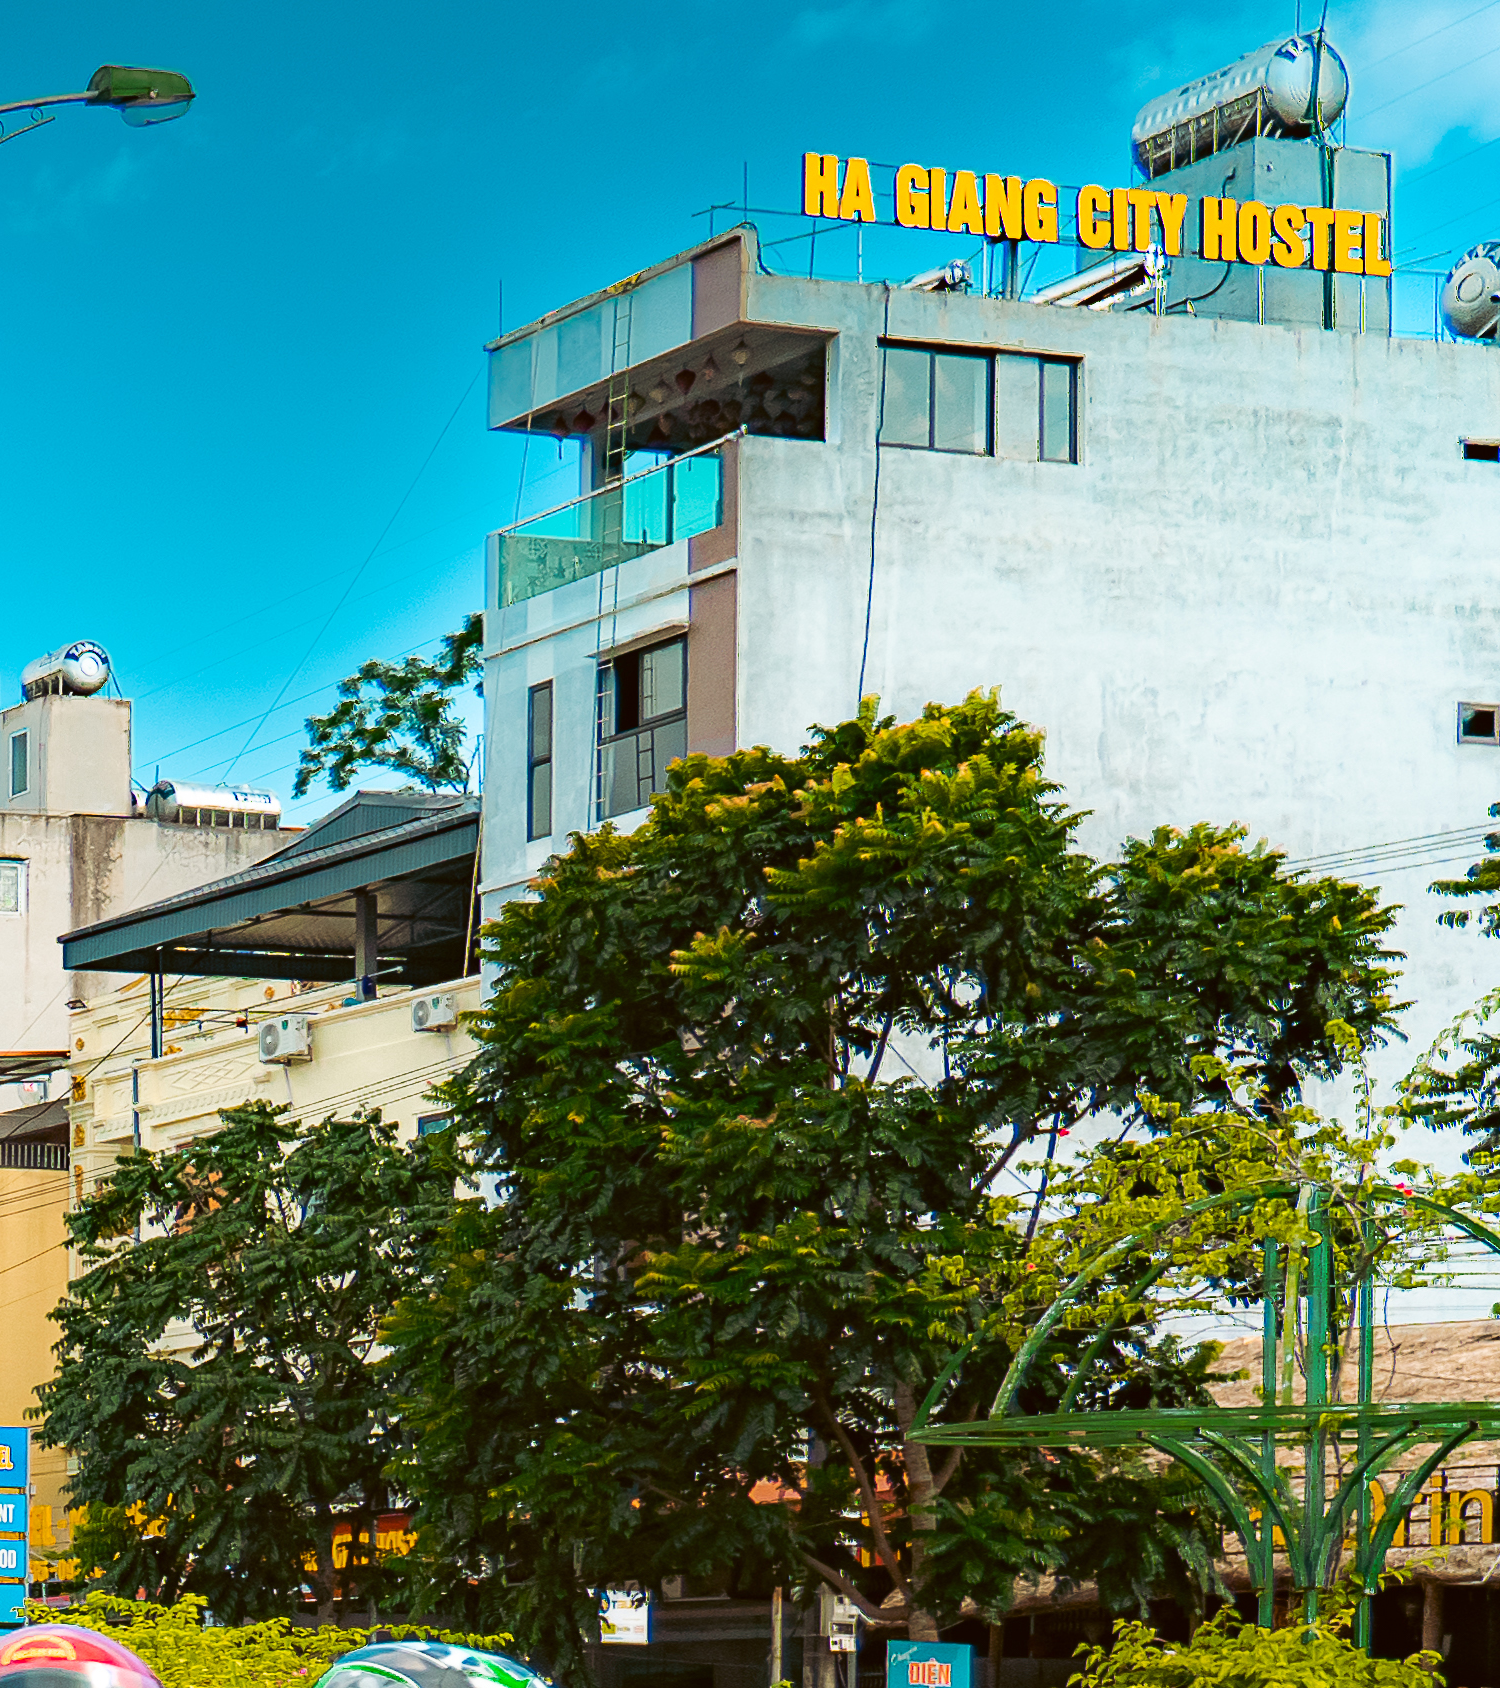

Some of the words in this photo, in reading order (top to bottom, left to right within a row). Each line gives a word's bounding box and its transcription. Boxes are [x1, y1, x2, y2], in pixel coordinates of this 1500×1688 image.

[803, 152, 876, 223] HA
[896, 163, 1060, 244] GIANG
[1078, 184, 1188, 256] CITY
[1201, 195, 1392, 278] HOSTEL
